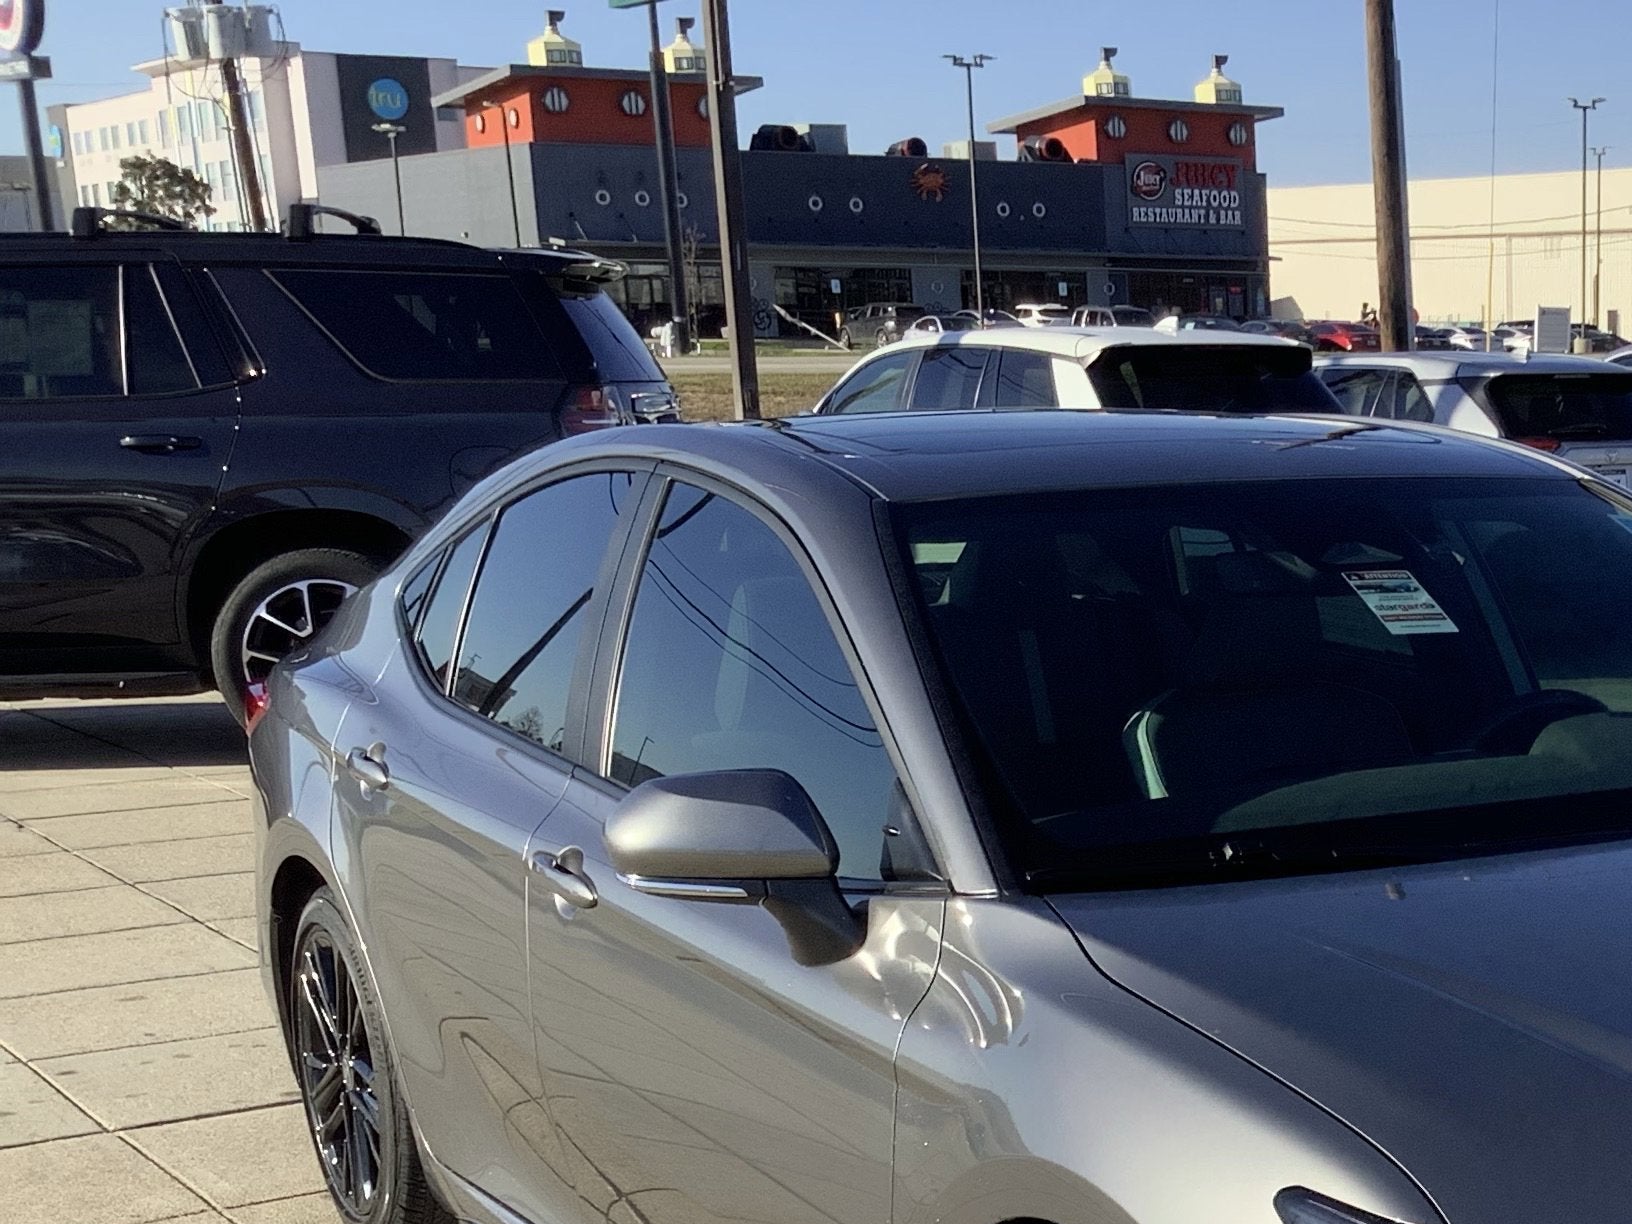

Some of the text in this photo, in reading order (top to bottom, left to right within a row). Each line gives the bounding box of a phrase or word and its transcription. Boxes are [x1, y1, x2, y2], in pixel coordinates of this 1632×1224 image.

[1170, 162, 1236, 190] JUICY
[1174, 188, 1240, 208] SEAFOOD
[1132, 206, 1242, 225] RESTAURANT & BAR
